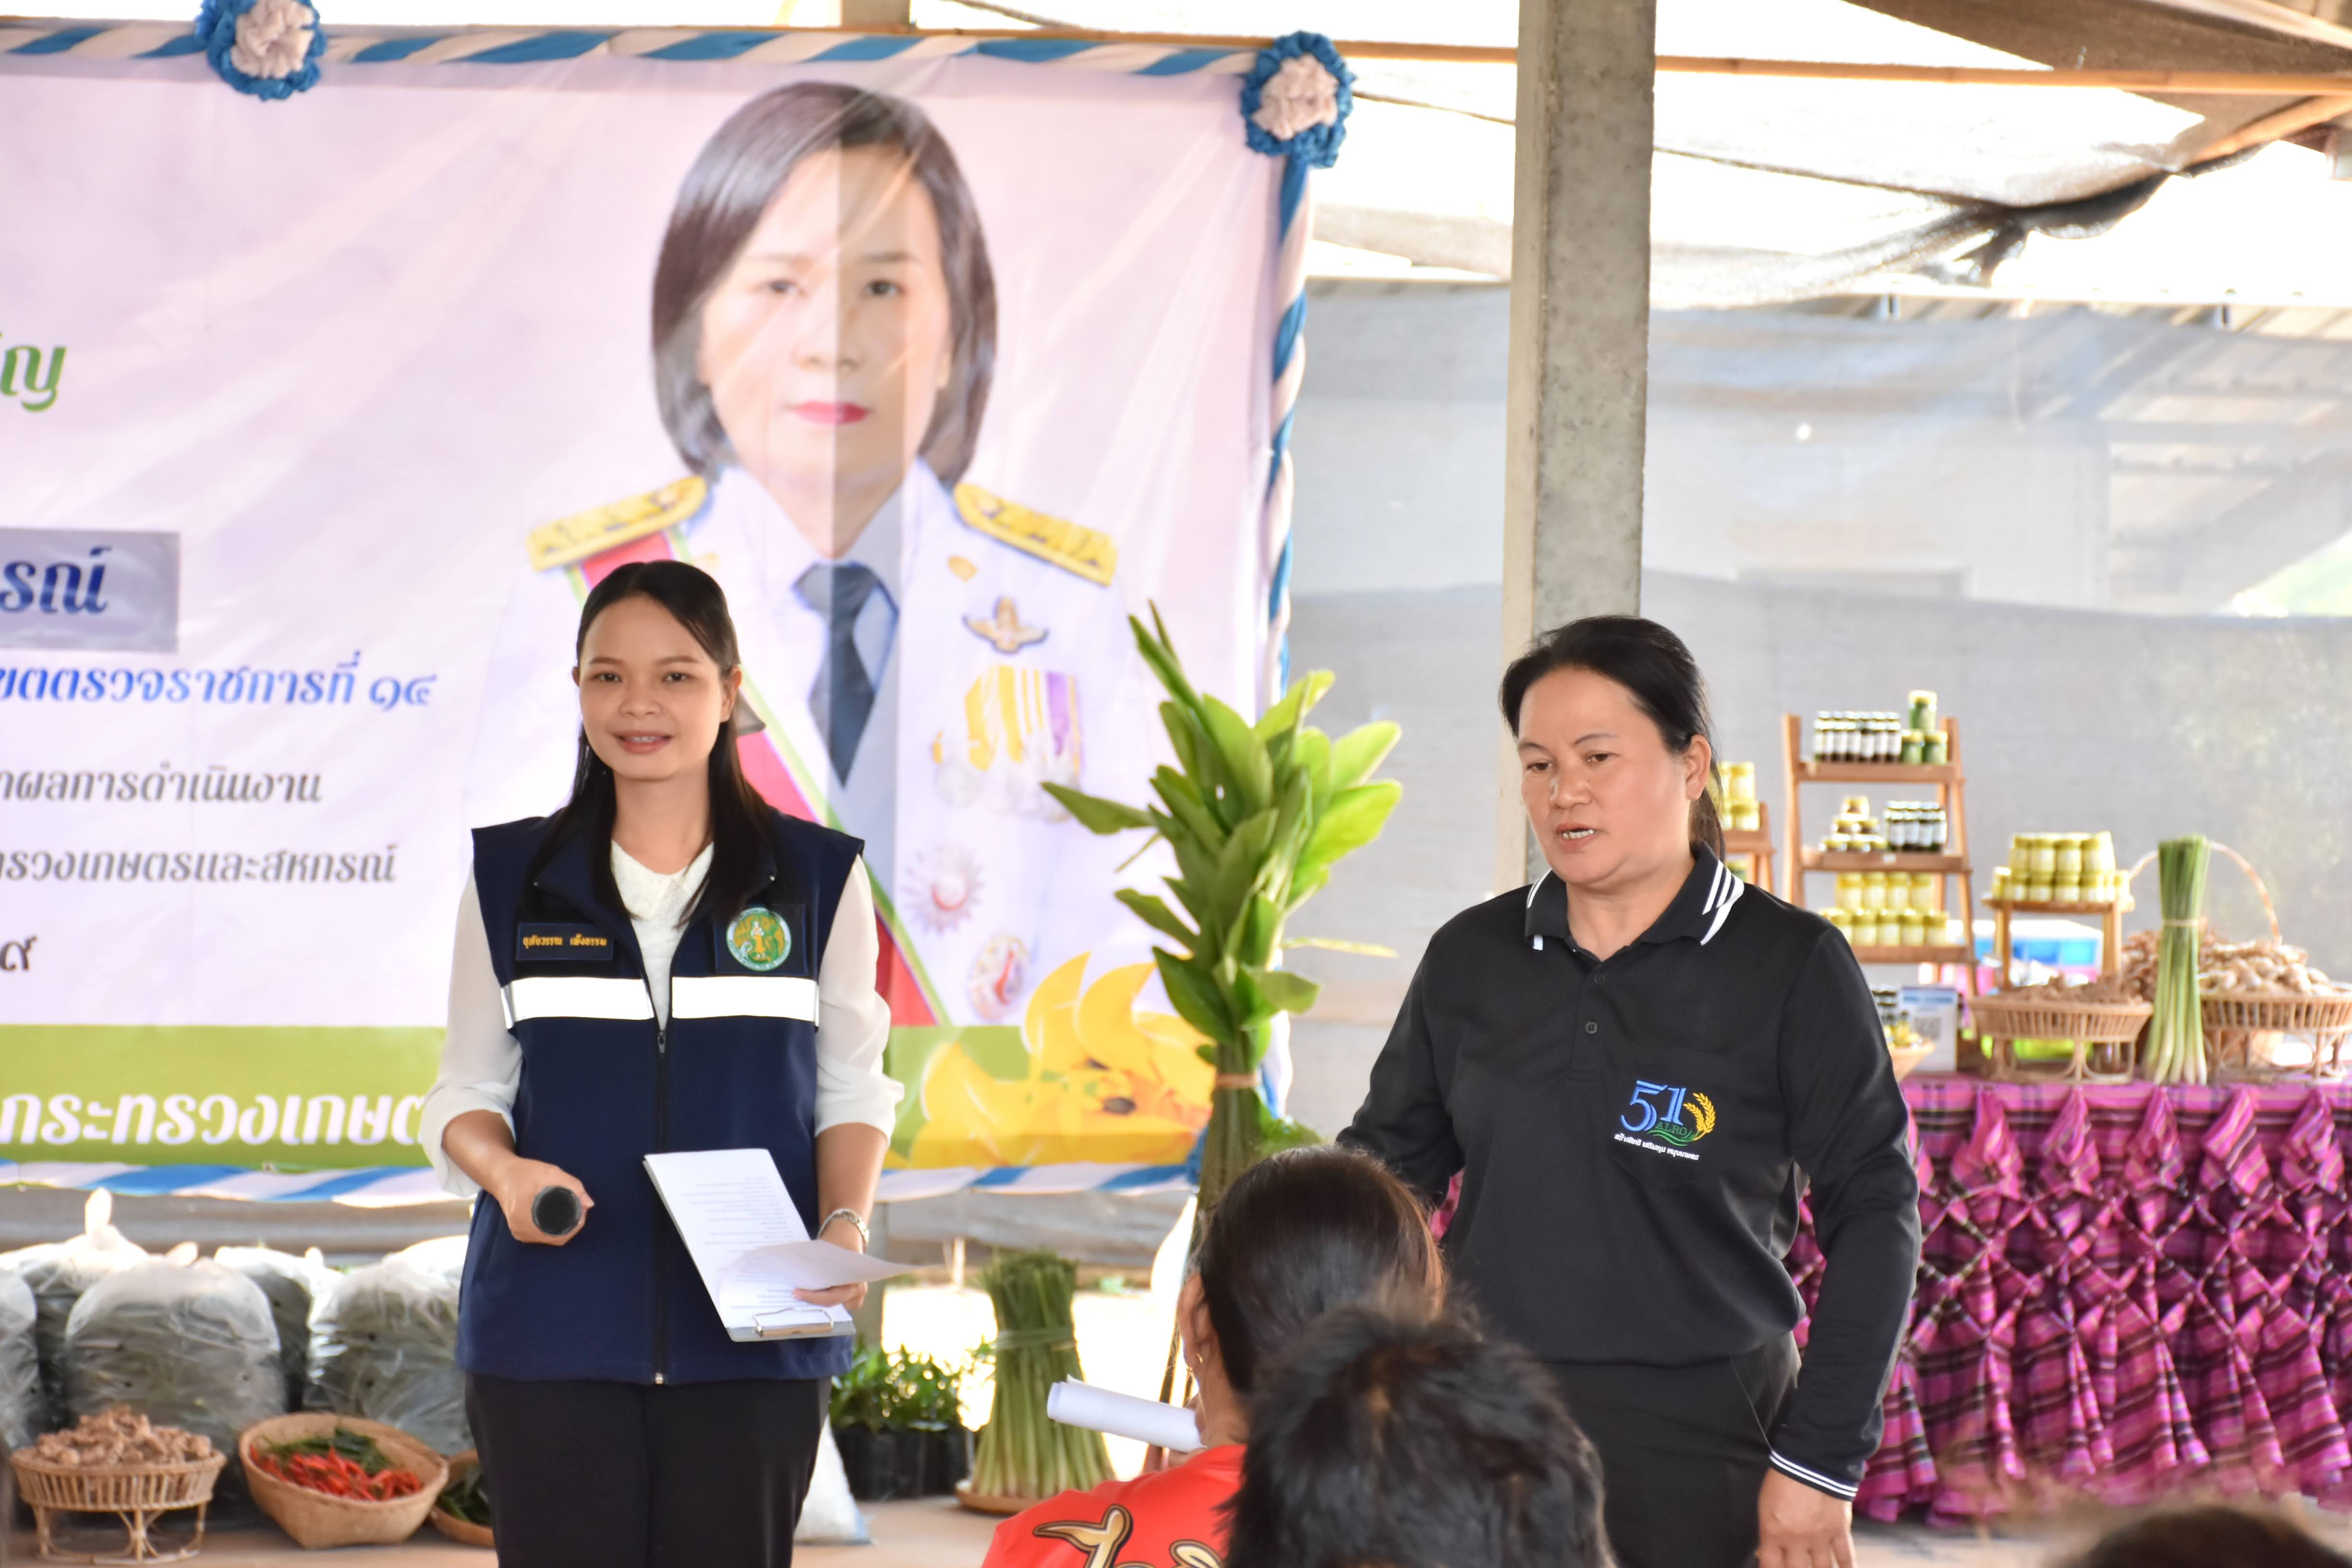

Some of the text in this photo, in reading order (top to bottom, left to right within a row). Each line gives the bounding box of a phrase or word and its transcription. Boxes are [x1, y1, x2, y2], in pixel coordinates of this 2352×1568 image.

[0, 333, 68, 413] ญ
[369, 674, 437, 712] ๑๔
[1620, 1080, 1687, 1131] 51
[1655, 1121, 1687, 1136] ALRO
